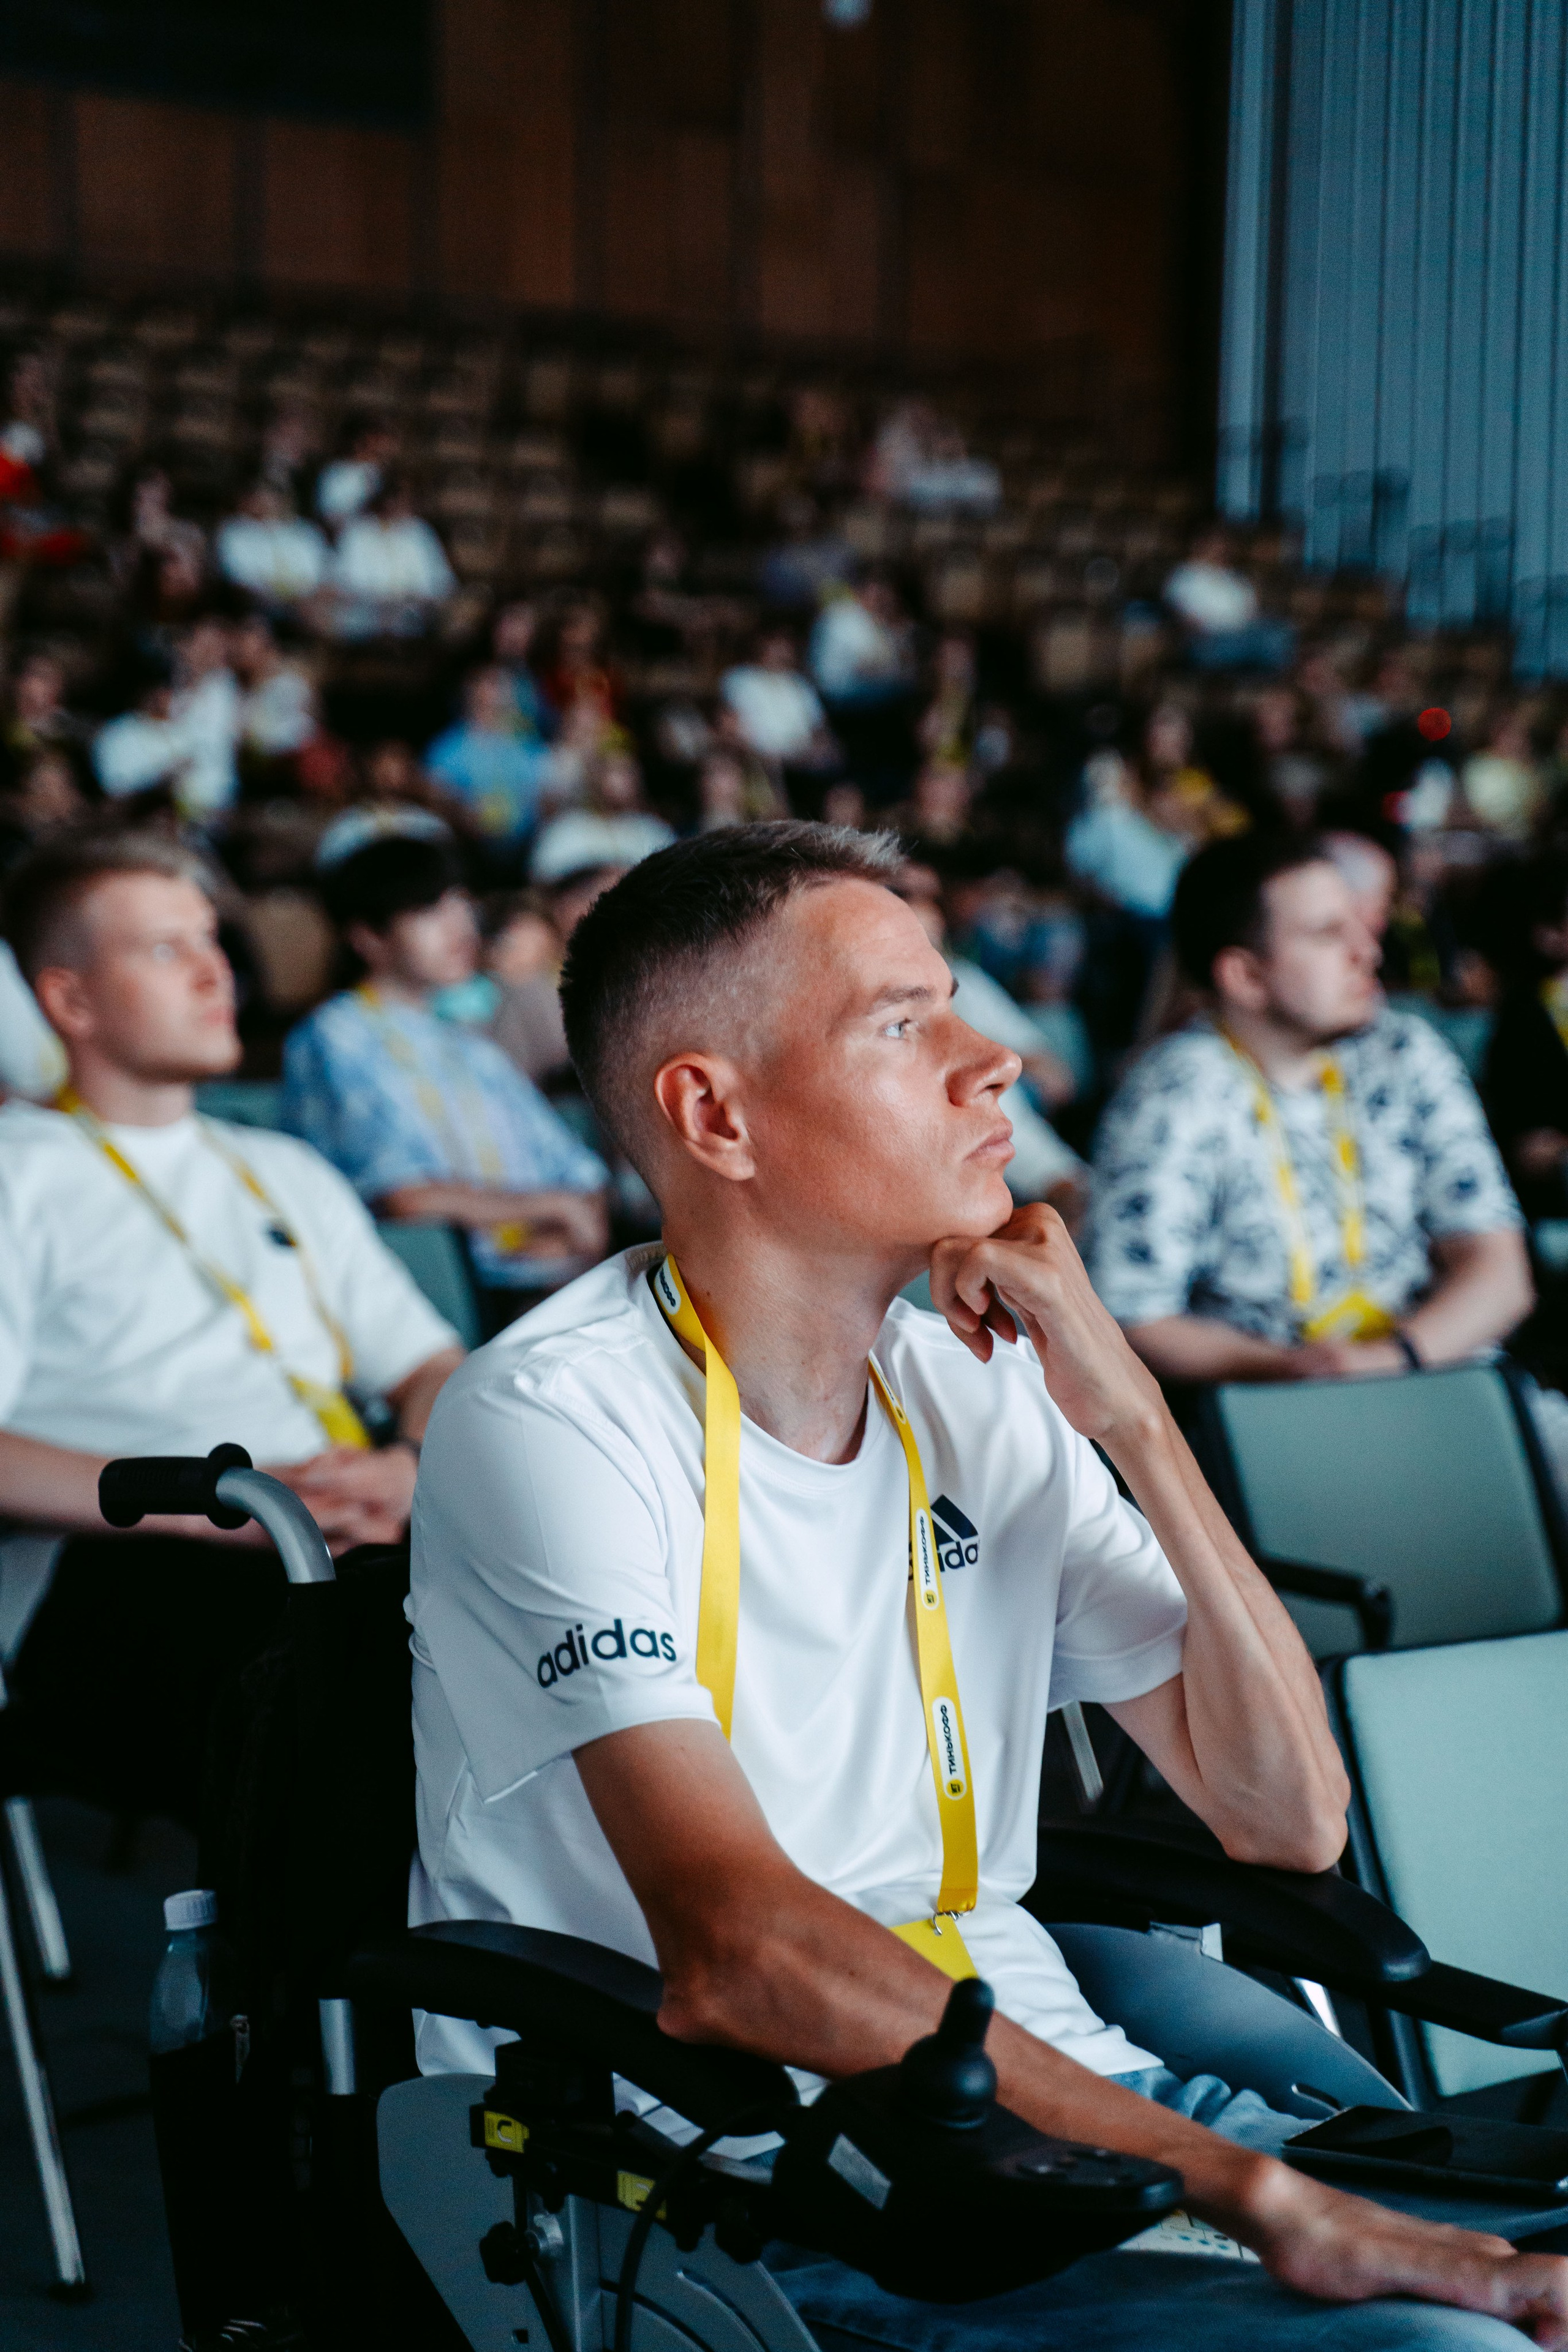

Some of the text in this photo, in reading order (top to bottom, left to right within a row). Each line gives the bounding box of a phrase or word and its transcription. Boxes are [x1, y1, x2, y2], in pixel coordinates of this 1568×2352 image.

[919, 1515, 931, 1586] ТИНЬКОФФ
[538, 1618, 677, 1689] adidas
[941, 1705, 956, 1776] ТИНЬКОФФ
